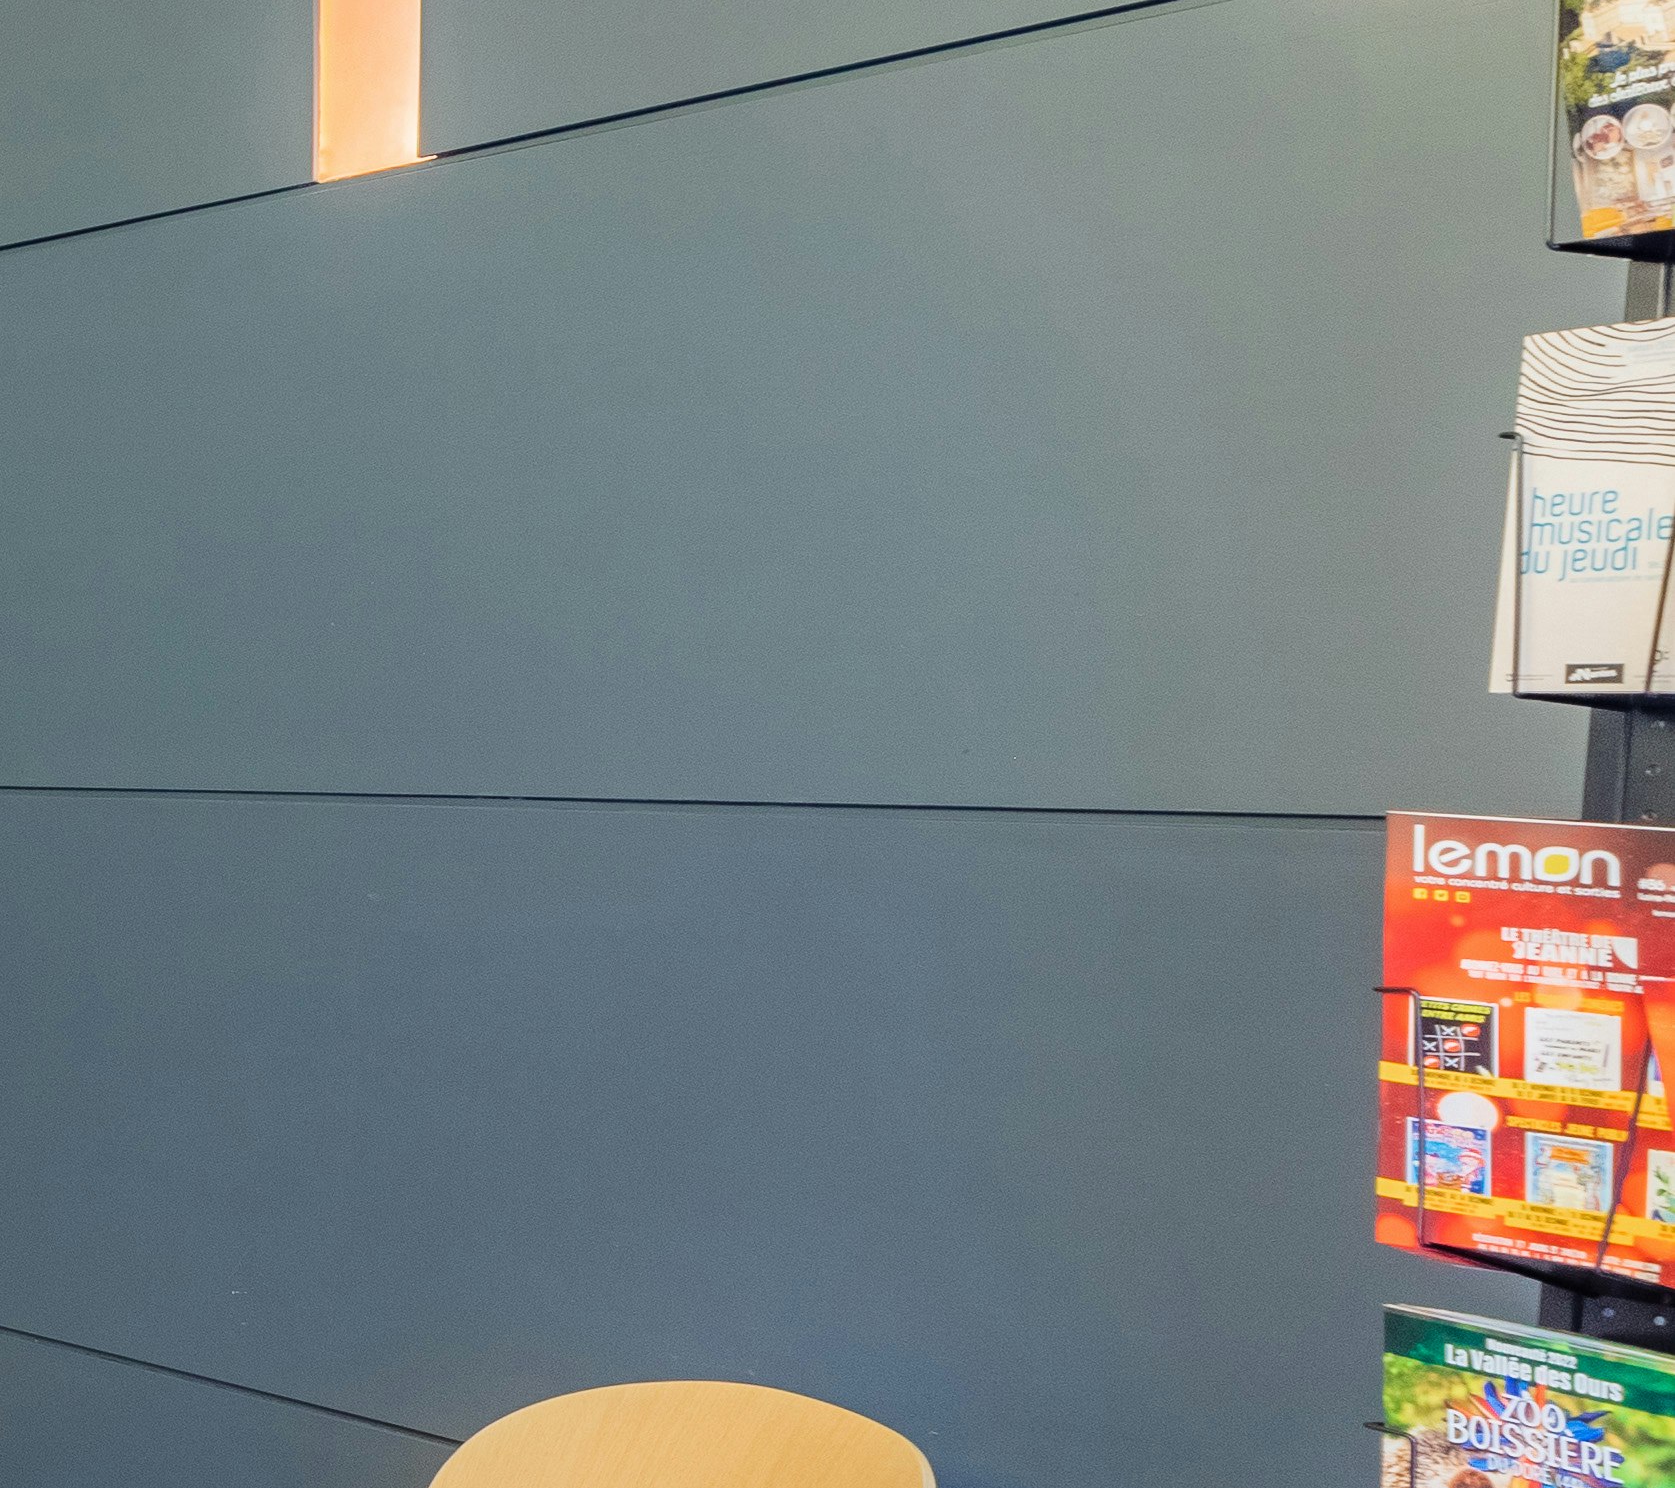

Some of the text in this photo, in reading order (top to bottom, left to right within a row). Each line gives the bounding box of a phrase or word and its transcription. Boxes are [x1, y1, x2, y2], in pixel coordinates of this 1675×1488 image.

[1532, 487, 1618, 517] heure
[1529, 508, 1675, 547] musicale
[1558, 541, 1637, 582] jeudi
[1413, 824, 1621, 887] lemon
[1444, 1342, 1625, 1403] La Vallée des Ours
[1499, 1390, 1567, 1434] ZOO
[1446, 1407, 1626, 1485] BOISSIÈRE
